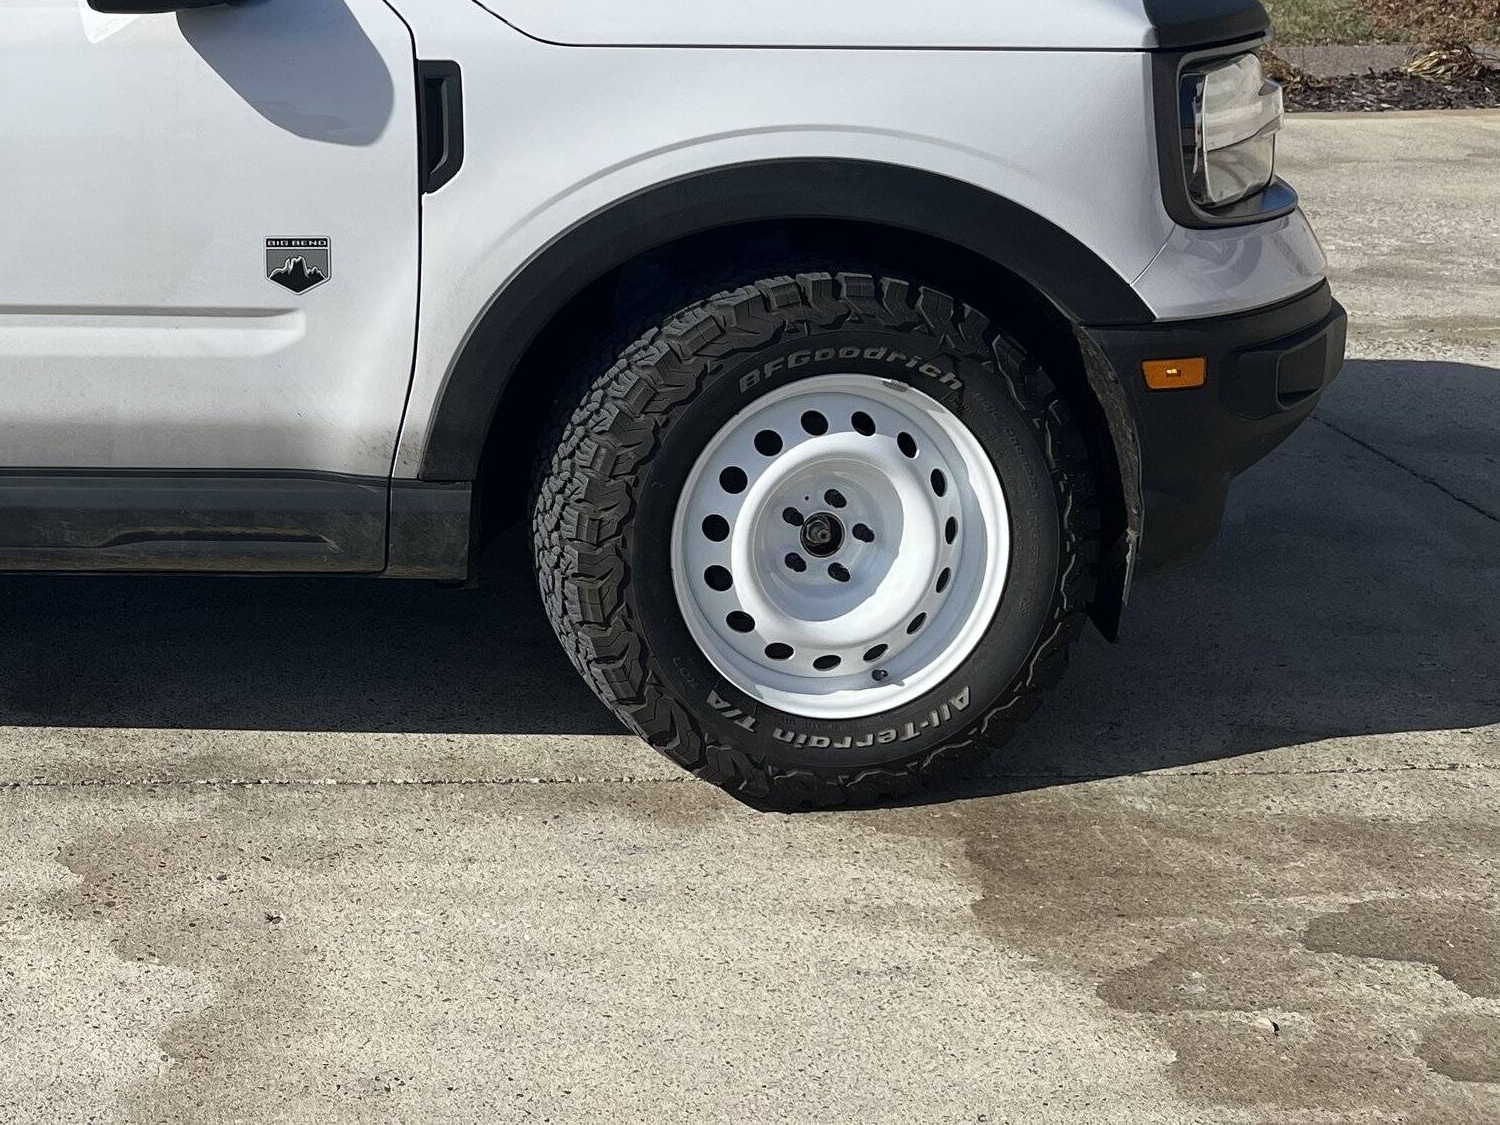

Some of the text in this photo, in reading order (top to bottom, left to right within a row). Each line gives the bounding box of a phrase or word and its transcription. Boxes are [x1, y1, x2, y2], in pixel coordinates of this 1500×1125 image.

[739, 347, 963, 393] BFGoodrich
[706, 685, 971, 749] All-Terrain T/A
